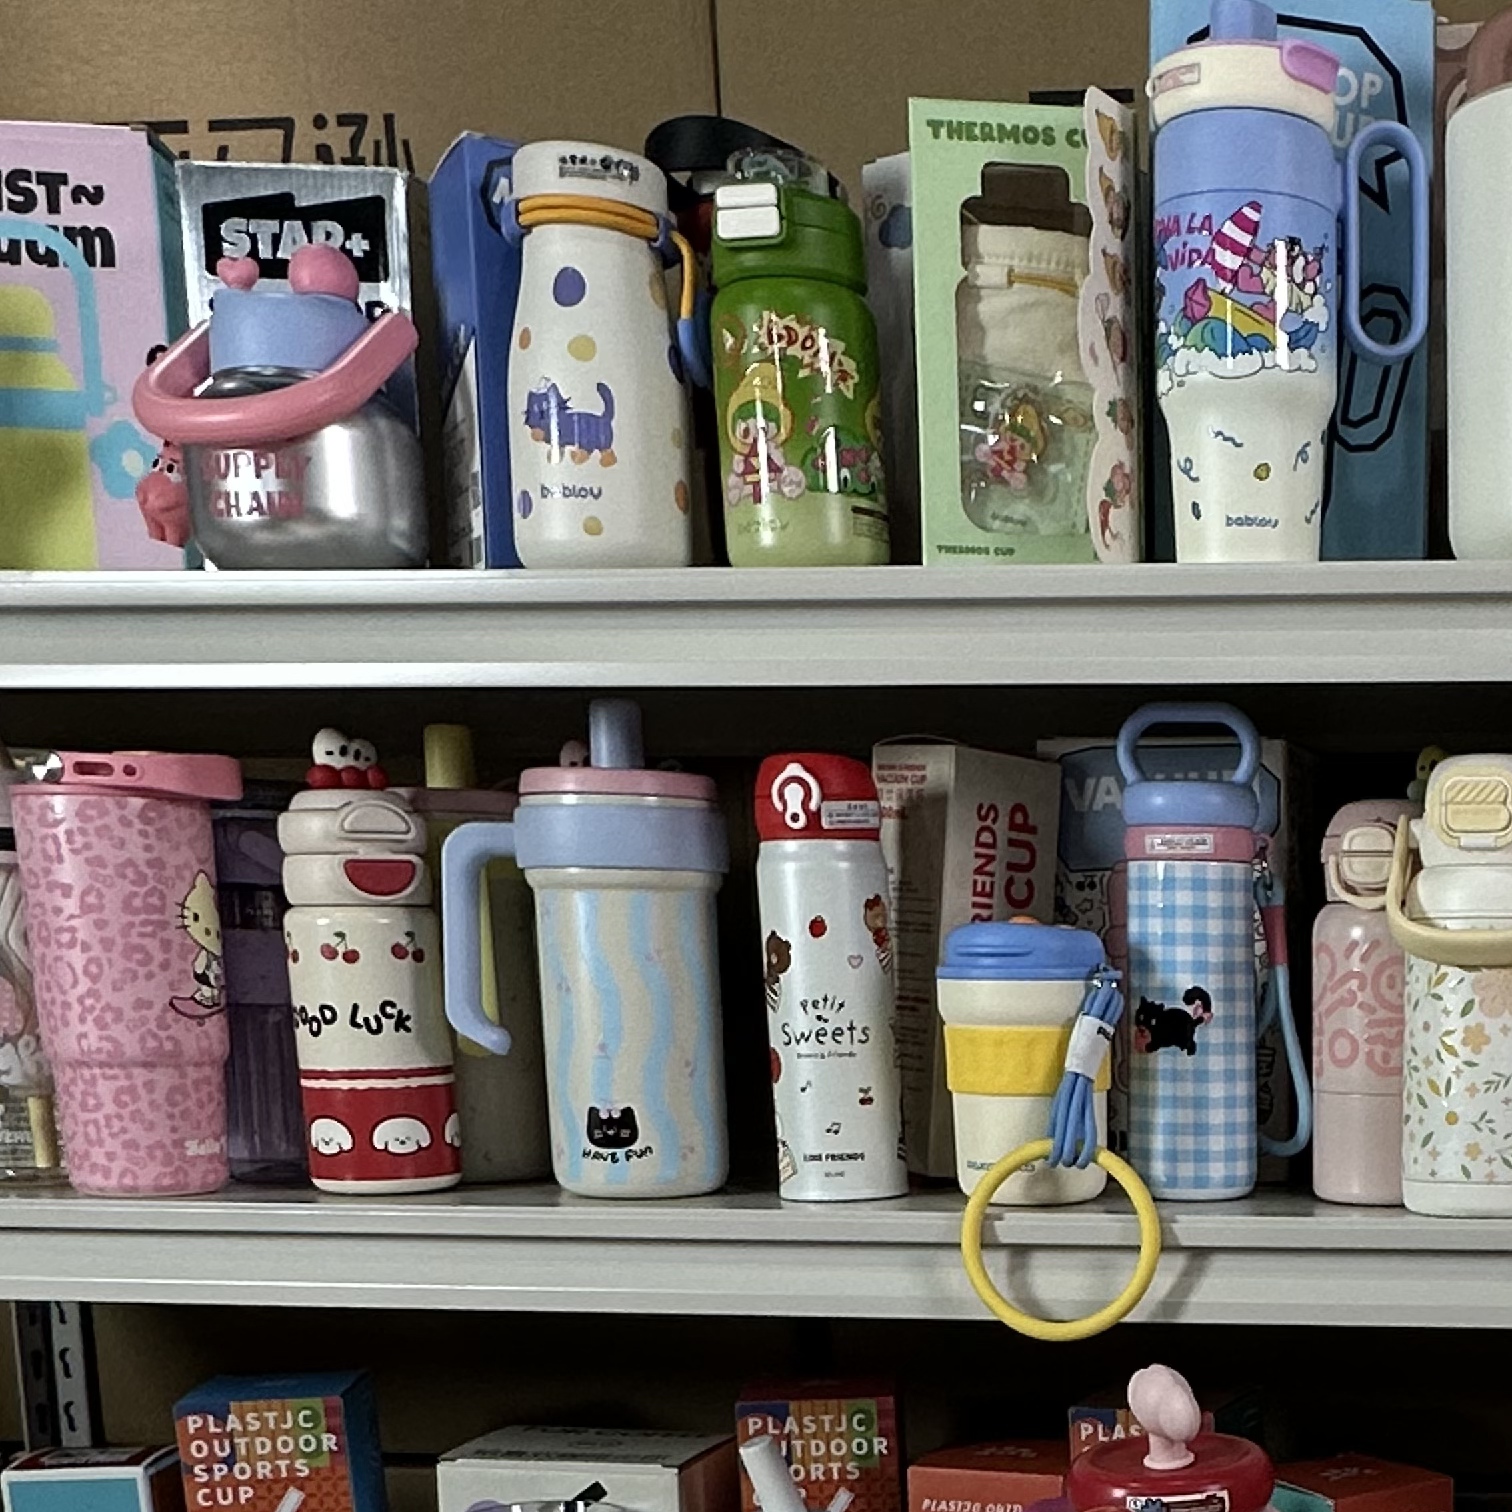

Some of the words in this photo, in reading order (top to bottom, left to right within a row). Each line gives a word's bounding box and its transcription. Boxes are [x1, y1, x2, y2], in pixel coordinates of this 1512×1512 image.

[926, 119, 1055, 147] THERMOS
[1004, 802, 1039, 911] CUP
[349, 1000, 412, 1035] LUCK
[781, 1017, 870, 1047] Sweets
[1079, 1423, 1142, 1441] PLAS
[189, 1433, 340, 1459] OUTDOOR
[780, 1435, 889, 1458] TDOOR
[193, 1459, 311, 1483] SPORTS
[790, 1460, 861, 1481] ORTS
[196, 1485, 256, 1507] CUP
